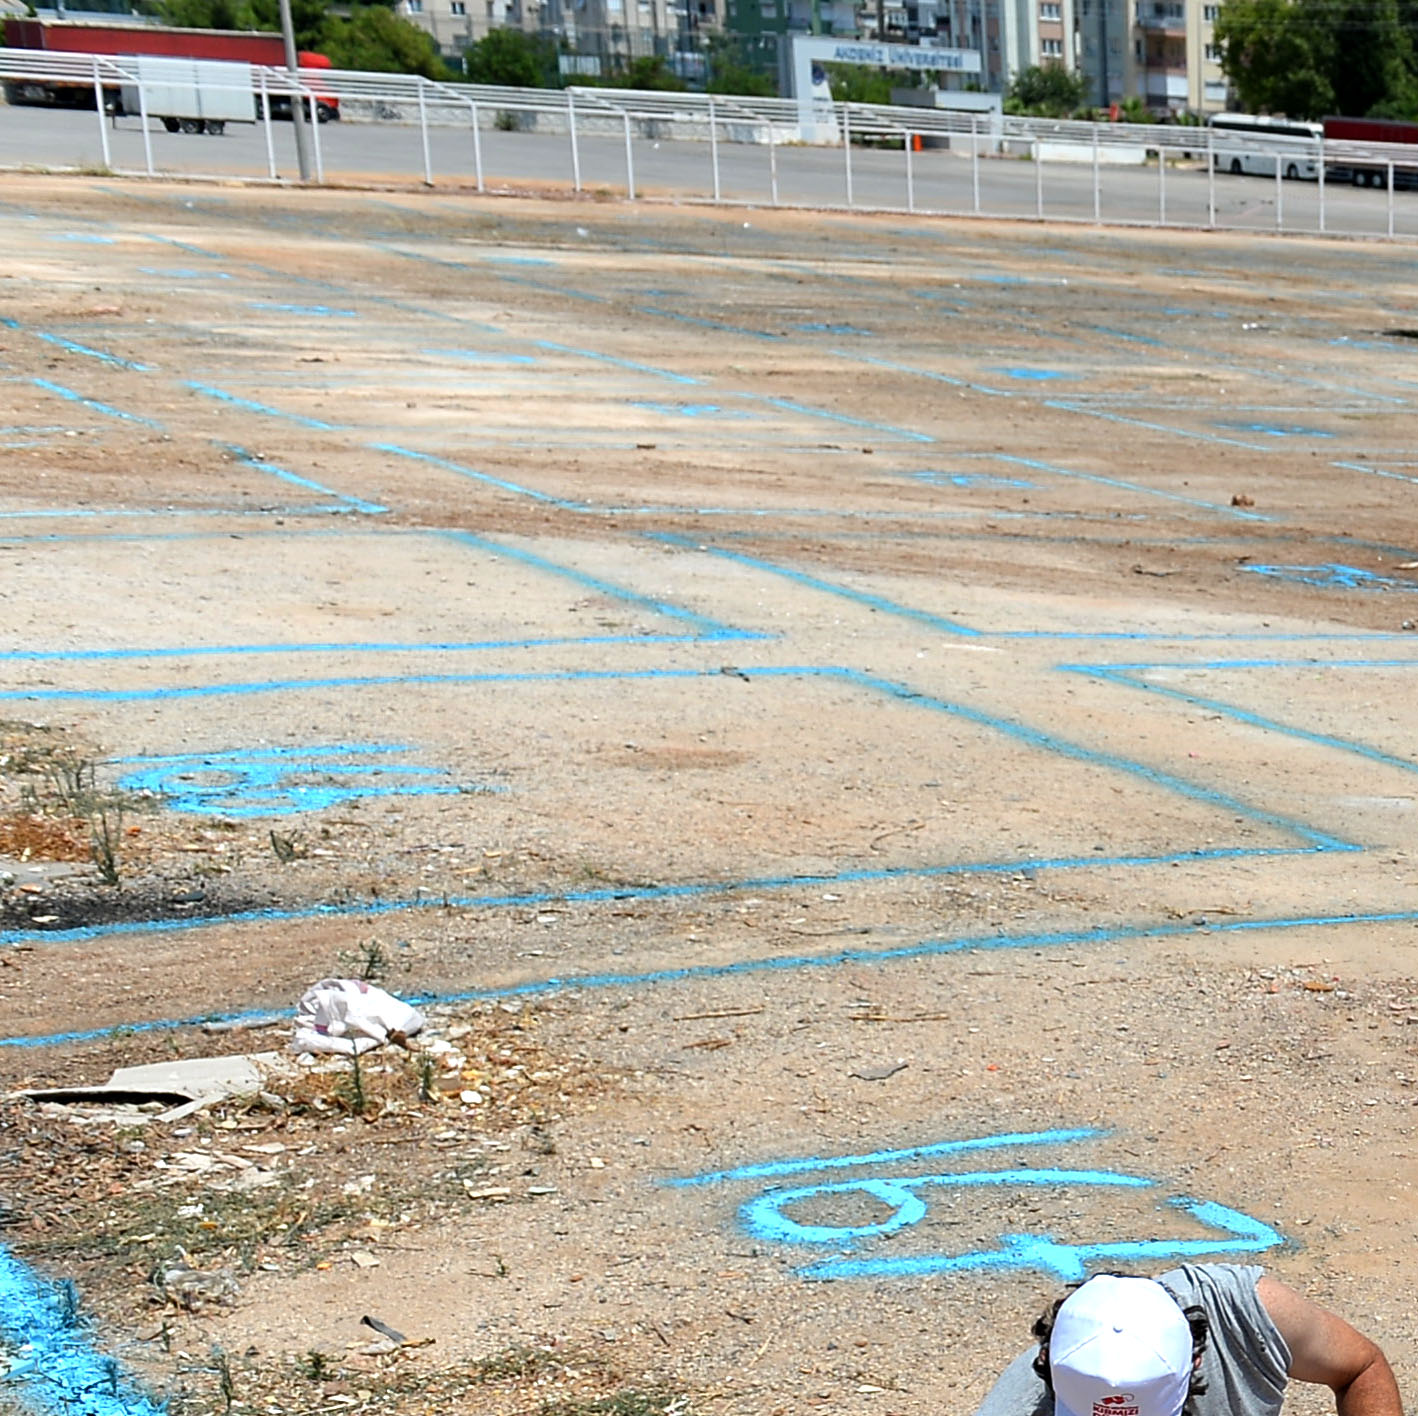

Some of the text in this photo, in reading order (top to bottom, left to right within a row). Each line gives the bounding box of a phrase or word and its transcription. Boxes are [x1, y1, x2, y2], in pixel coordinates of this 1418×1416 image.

[834, 46, 964, 68] AKDENİZ ÜNİVERSİTESİ
[1093, 1405, 1139, 1416] KIRMIZI
